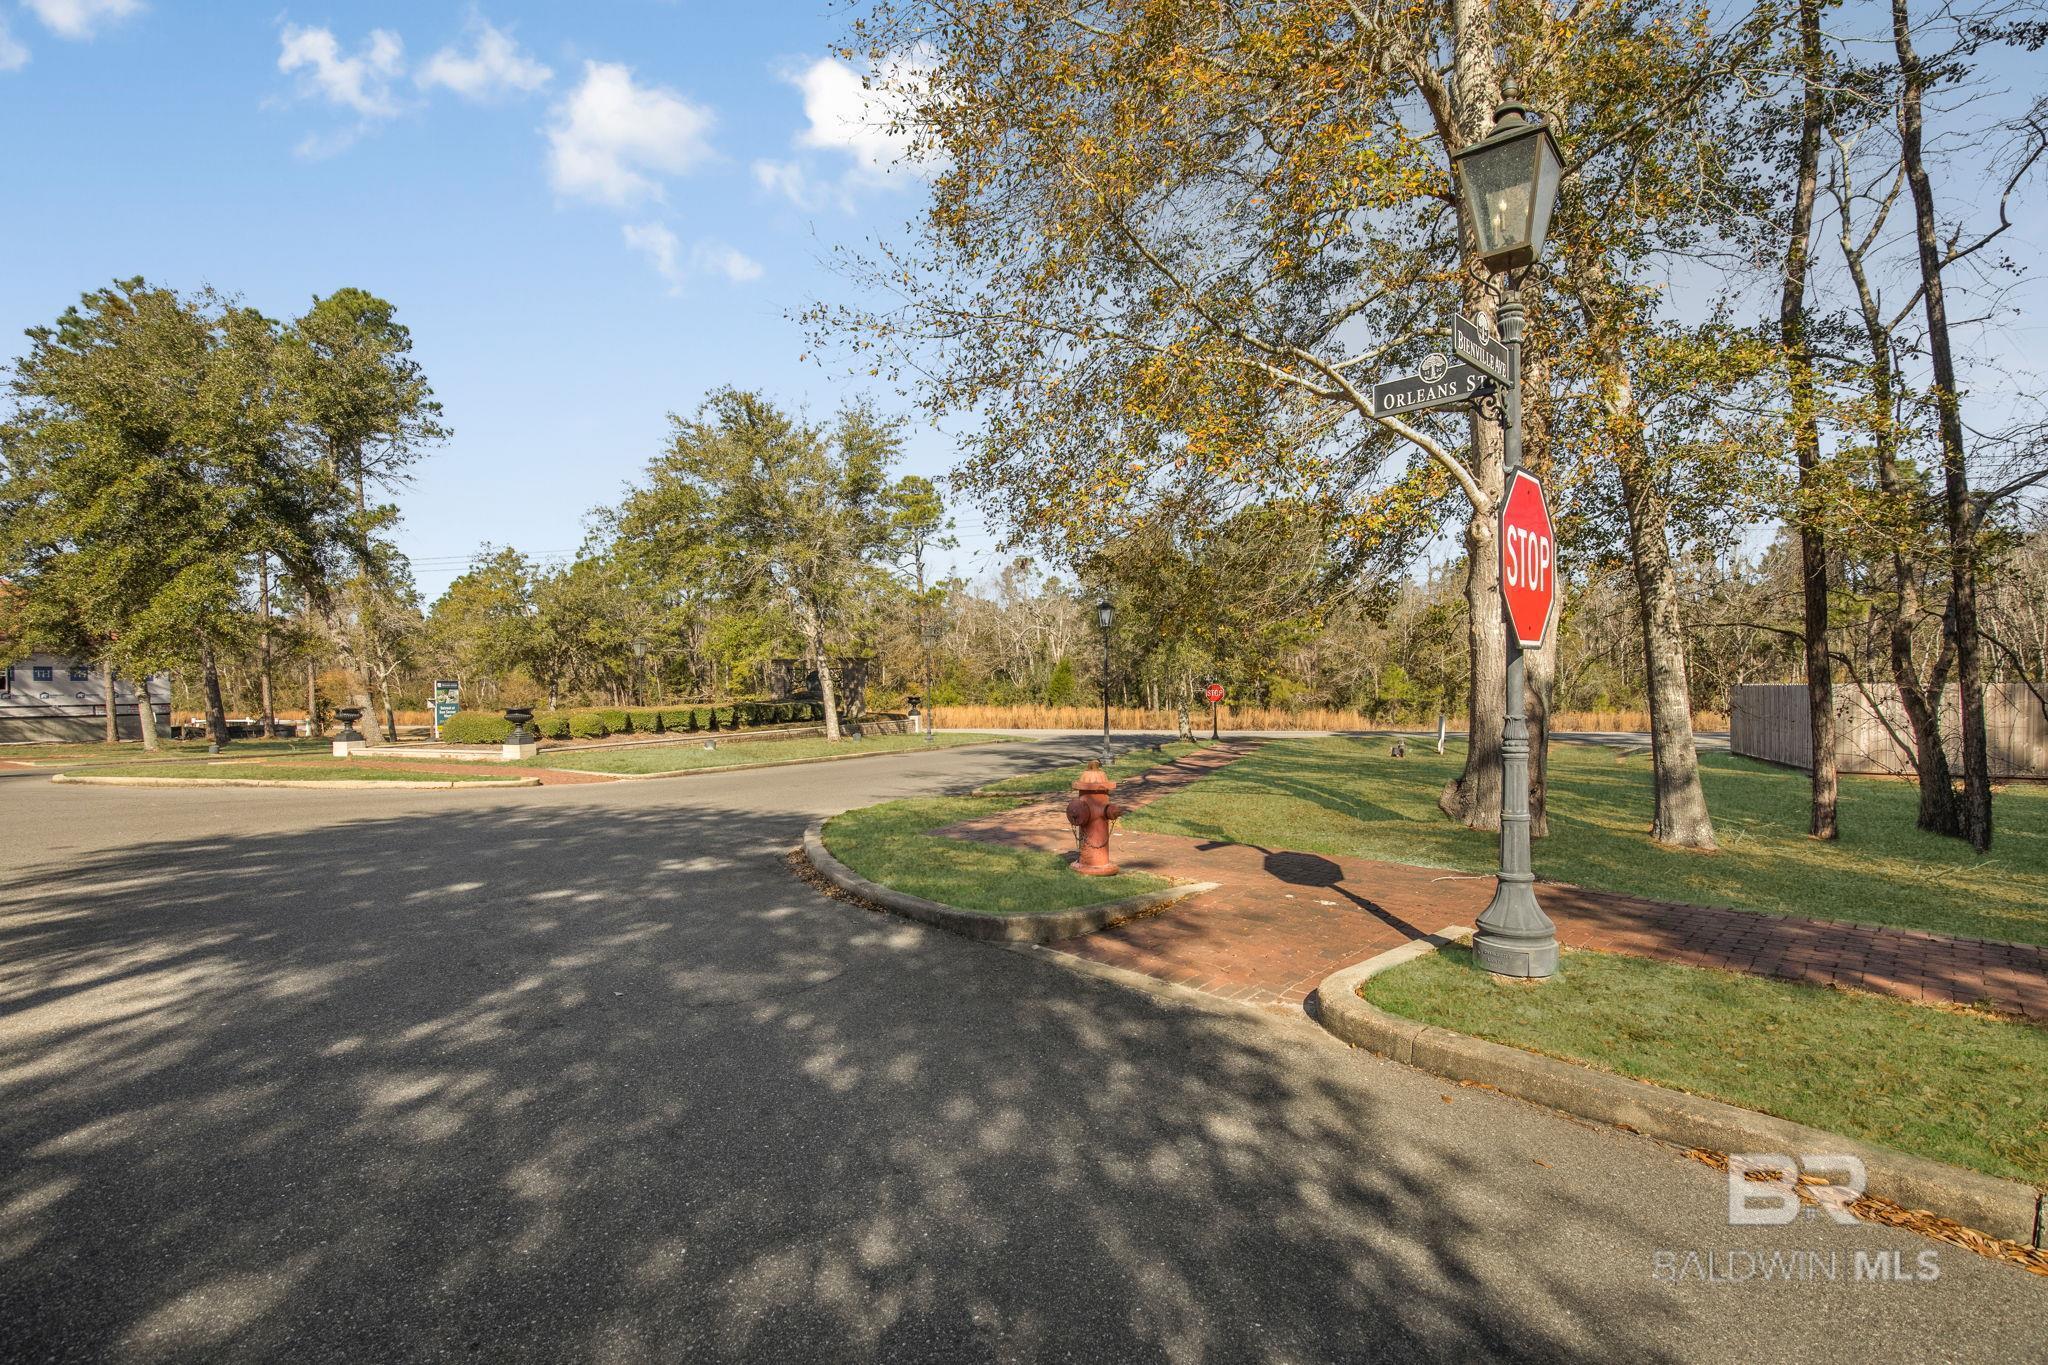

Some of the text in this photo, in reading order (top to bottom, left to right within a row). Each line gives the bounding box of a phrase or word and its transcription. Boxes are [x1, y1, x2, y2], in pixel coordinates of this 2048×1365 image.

[1457, 329, 1507, 378] BIENVILLE AVE
[1383, 374, 1488, 410] ORLEANS ST
[1506, 523, 1550, 592] STOP
[1207, 689, 1223, 697] STOP
